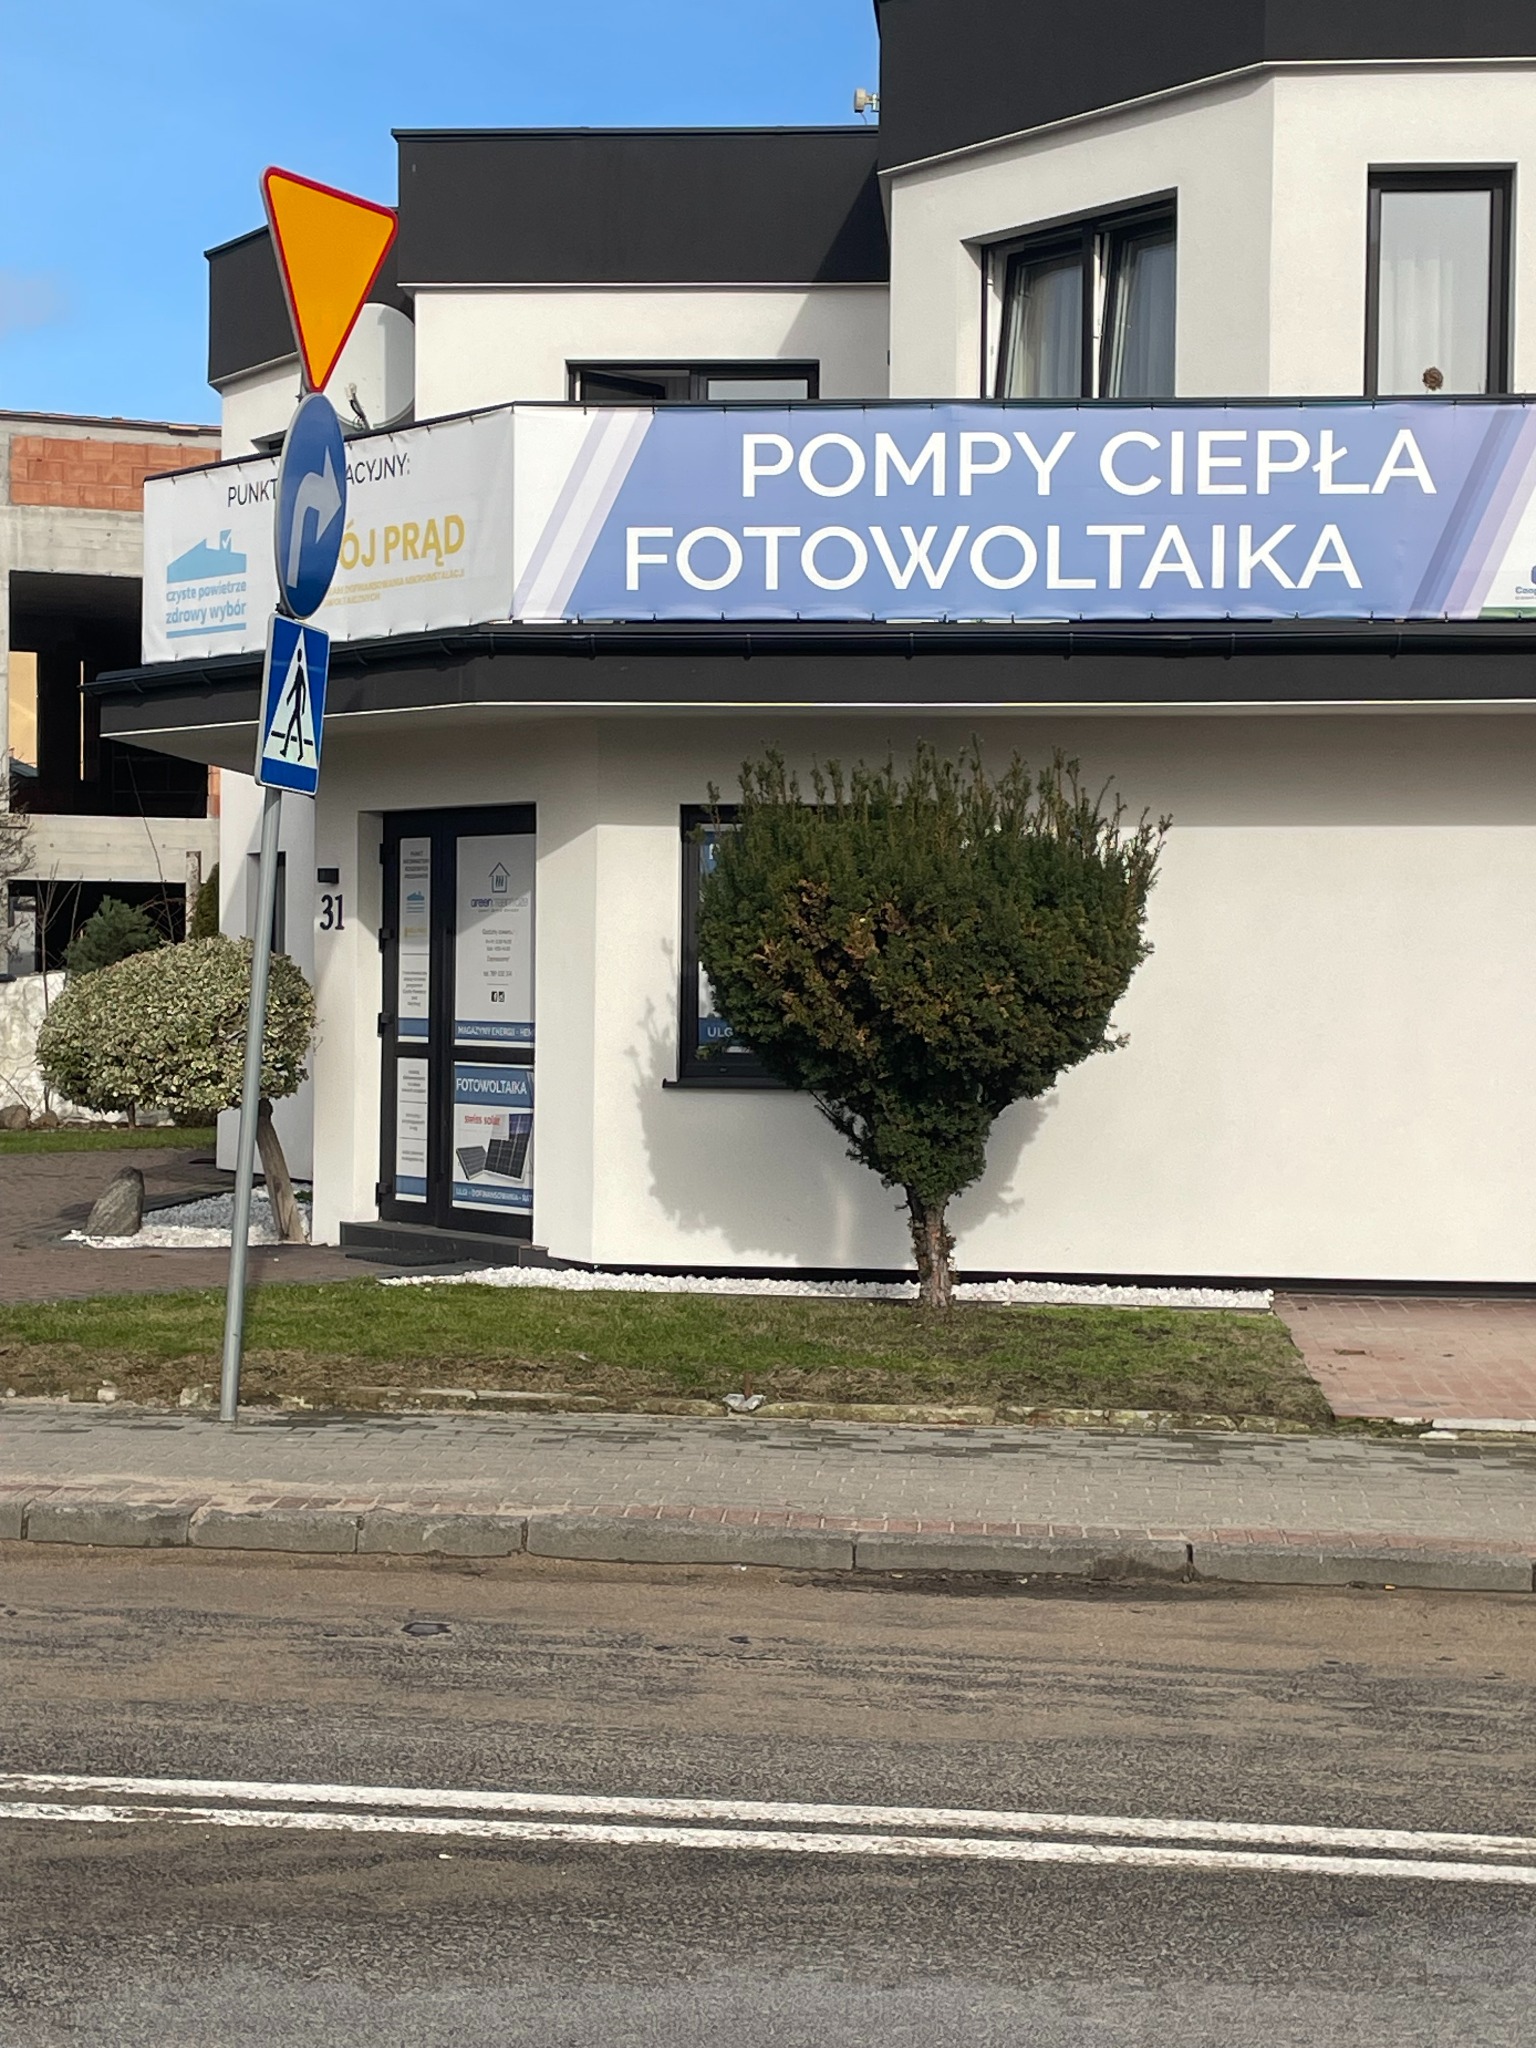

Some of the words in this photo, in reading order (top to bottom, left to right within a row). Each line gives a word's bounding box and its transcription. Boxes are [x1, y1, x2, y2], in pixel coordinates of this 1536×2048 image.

[227, 478, 278, 508] PUNKT
[345, 452, 411, 486] ACYJNY:
[742, 431, 1076, 498] POMPY
[1099, 428, 1437, 497] CIEPŁA
[339, 518, 376, 570] ÓJ
[384, 514, 465, 567] PRĄD
[625, 523, 1363, 591] FOTOWOLTAIKA
[166, 586, 197, 605] czyste
[198, 580, 247, 600] powietrze
[165, 607, 207, 625] zdrowy
[209, 598, 247, 622] wybór
[319, 894, 345, 930] 31
[707, 1026, 734, 1038] ULG
[456, 1077, 528, 1095] FOTOWOLTAIKA
